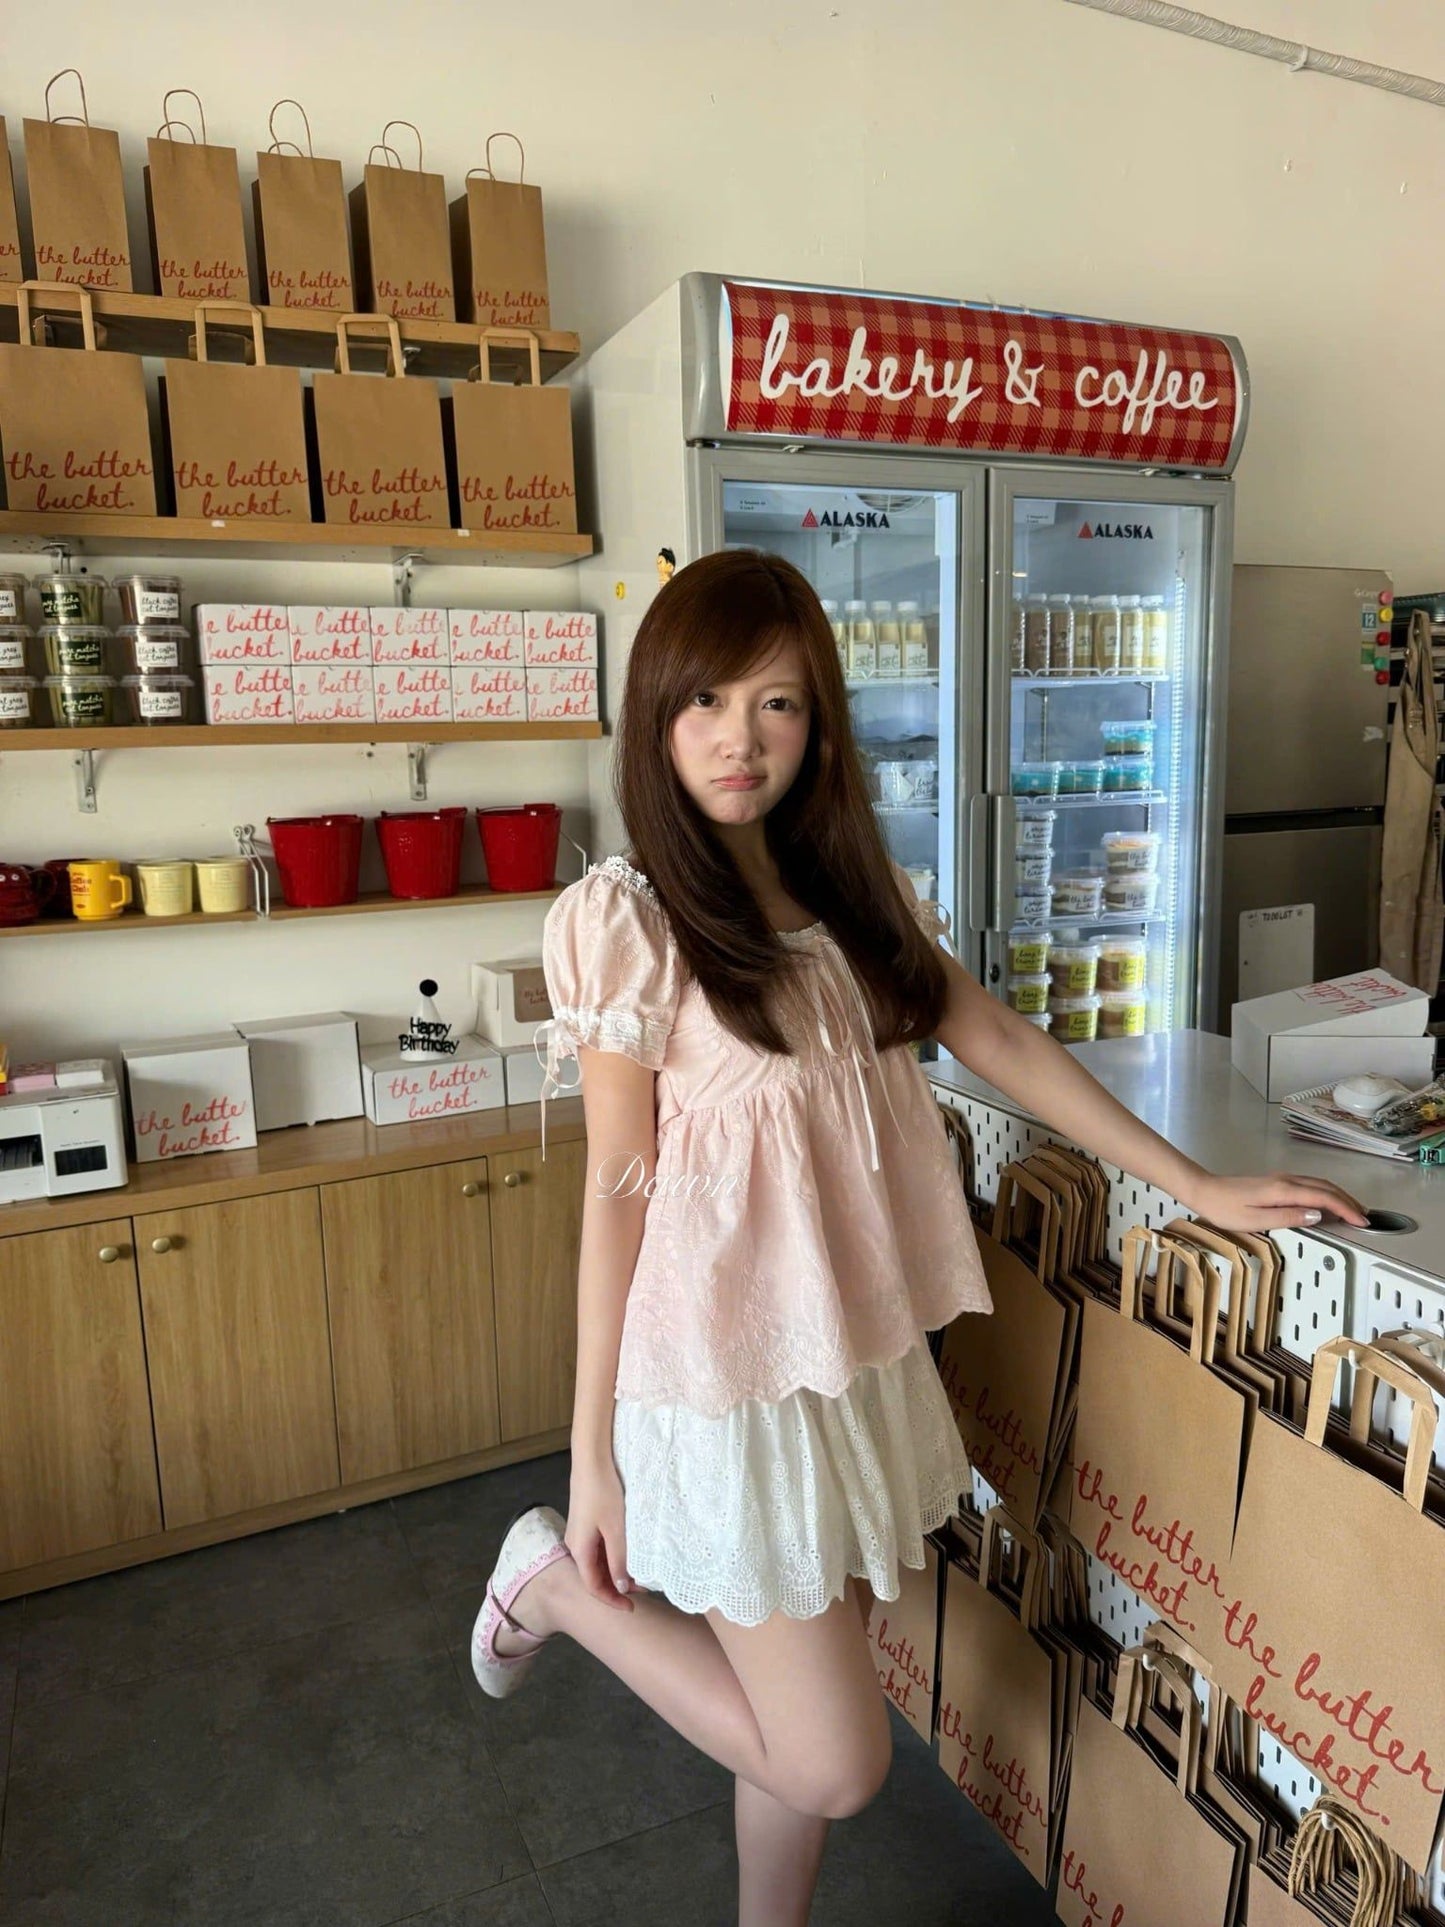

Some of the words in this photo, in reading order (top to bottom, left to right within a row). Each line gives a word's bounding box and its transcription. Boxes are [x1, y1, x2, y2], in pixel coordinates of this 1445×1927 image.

[36, 245, 67, 264] the
[73, 246, 131, 266] butter
[160, 260, 189, 278] the
[194, 261, 247, 280] butter
[55, 266, 118, 286] bucket.
[178, 281, 237, 299] bucket.
[269, 270, 295, 288] the
[300, 270, 350, 288] butter
[377, 280, 402, 298] the
[407, 281, 452, 299] butter
[284, 291, 340, 308] bucket.
[392, 301, 443, 318] bucket.
[475, 291, 501, 308] the
[504, 291, 549, 308] butter
[491, 309, 540, 326] bucket.
[760, 314, 983, 423] bakery
[1003, 339, 1044, 408] &
[1074, 349, 1219, 434] coffee
[6, 452, 55, 480] the
[64, 450, 153, 479] butter
[175, 461, 220, 489] the
[227, 460, 307, 488] butter
[37, 481, 135, 510] bucket.
[323, 470, 365, 496] the
[372, 467, 447, 493] butter
[460, 477, 500, 503] the
[505, 474, 574, 500] butter
[202, 490, 291, 518] bucket.
[350, 497, 431, 523] bucket.
[484, 503, 560, 530] bucket.
[820, 510, 890, 528] ALASKA
[1095, 522, 1153, 539] ALASKA
[410, 1016, 452, 1039] Happy
[398, 1034, 460, 1054] Birthday
[387, 1077, 424, 1099] the
[429, 1063, 491, 1091] butter
[409, 1086, 477, 1118] bucket.
[135, 1110, 175, 1136] the
[159, 1121, 240, 1156] bucket.
[975, 1386, 1041, 1476] butter
[1074, 1455, 1124, 1521] the
[1132, 1493, 1226, 1598] butter
[1096, 1523, 1196, 1632] bucket.
[878, 1618, 932, 1694] butter
[878, 1668, 917, 1720] cket.
[1223, 1599, 1282, 1679] the
[1294, 1652, 1443, 1794] butter
[940, 1702, 976, 1756] the
[982, 1734, 1047, 1828] butter
[1245, 1676, 1392, 1826] bucket.
[957, 1756, 1030, 1856] bucket.
[1062, 1851, 1102, 1920] the
